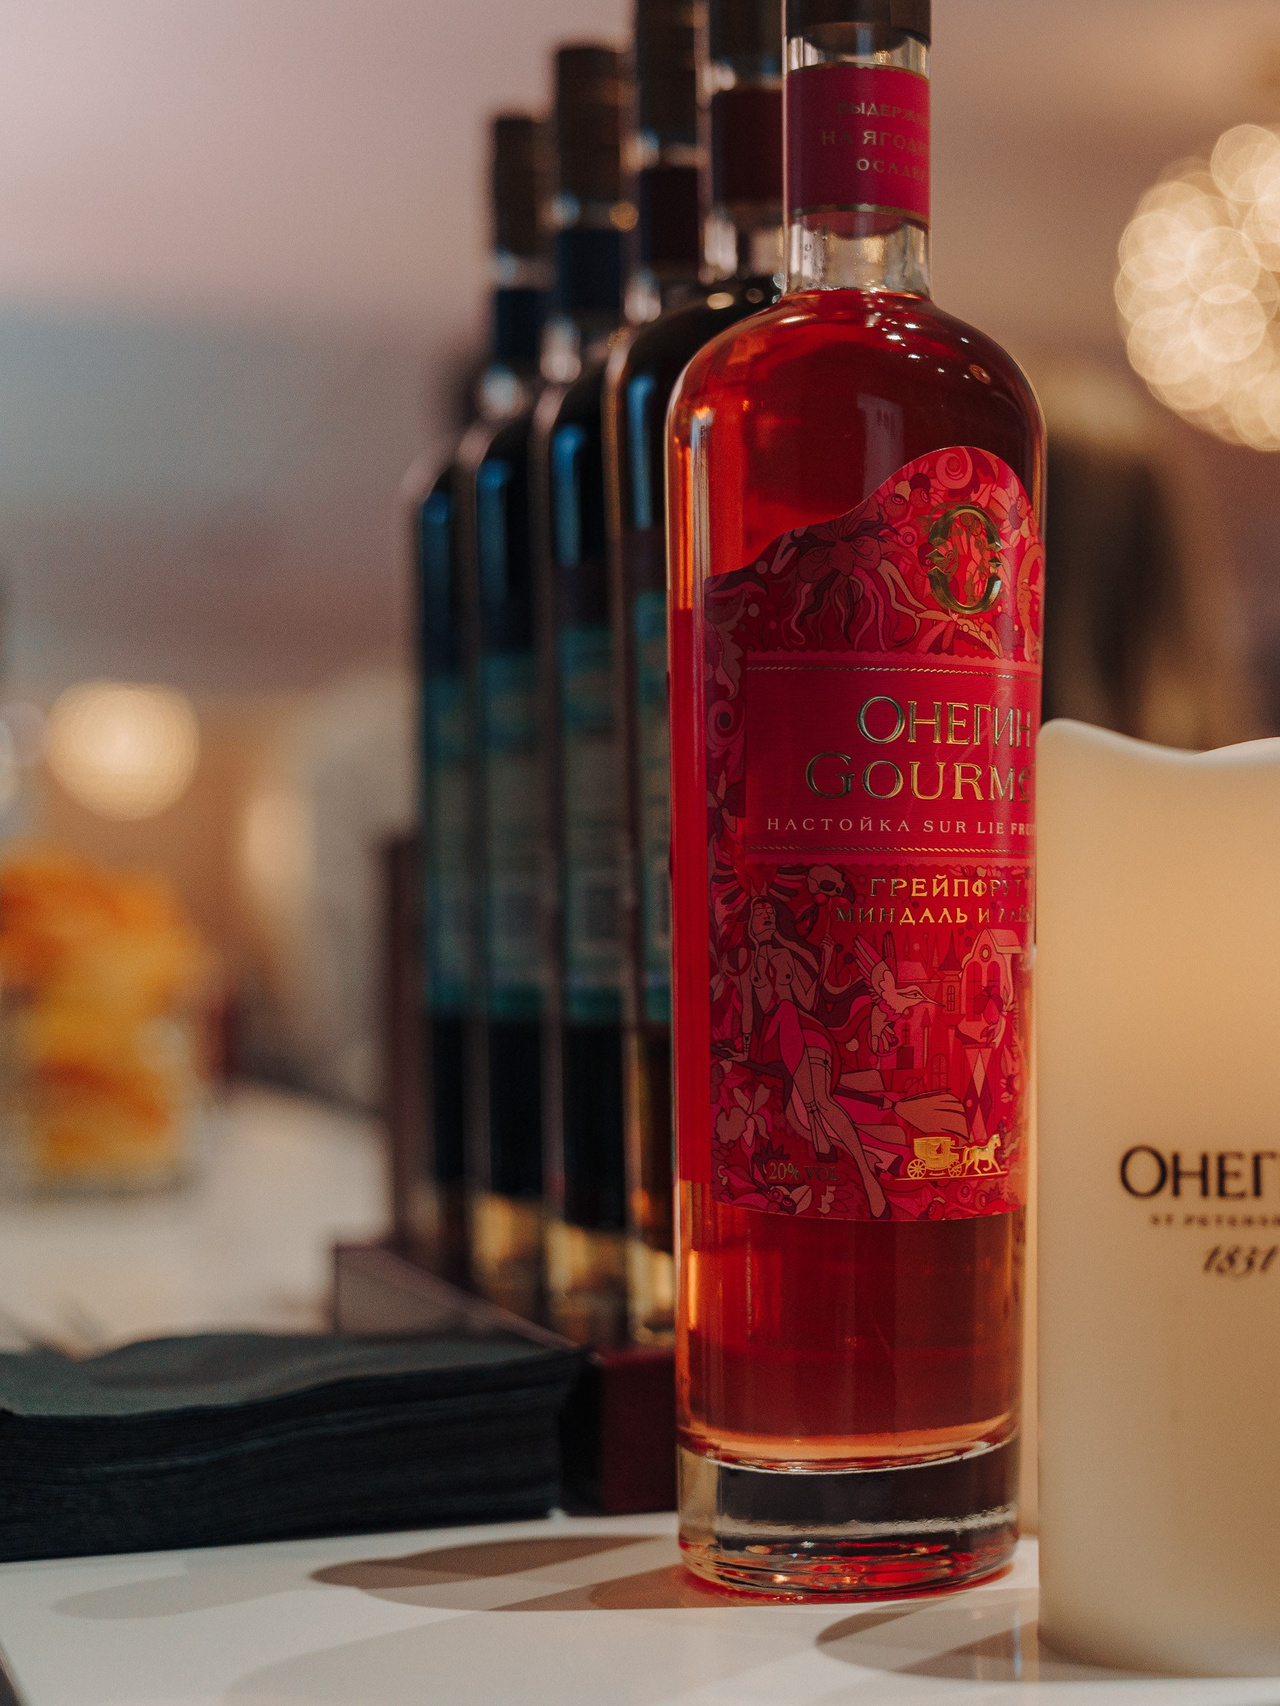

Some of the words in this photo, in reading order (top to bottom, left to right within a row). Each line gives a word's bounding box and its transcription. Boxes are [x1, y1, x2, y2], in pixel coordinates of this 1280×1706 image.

[857, 695, 1031, 749] ОНЕГИН
[767, 817, 910, 833] НАСТОЙКА
[923, 820, 967, 834] SUR
[977, 822, 1005, 835] LIE
[836, 907, 968, 925] МИНДАЛЬ
[978, 907, 990, 924] И
